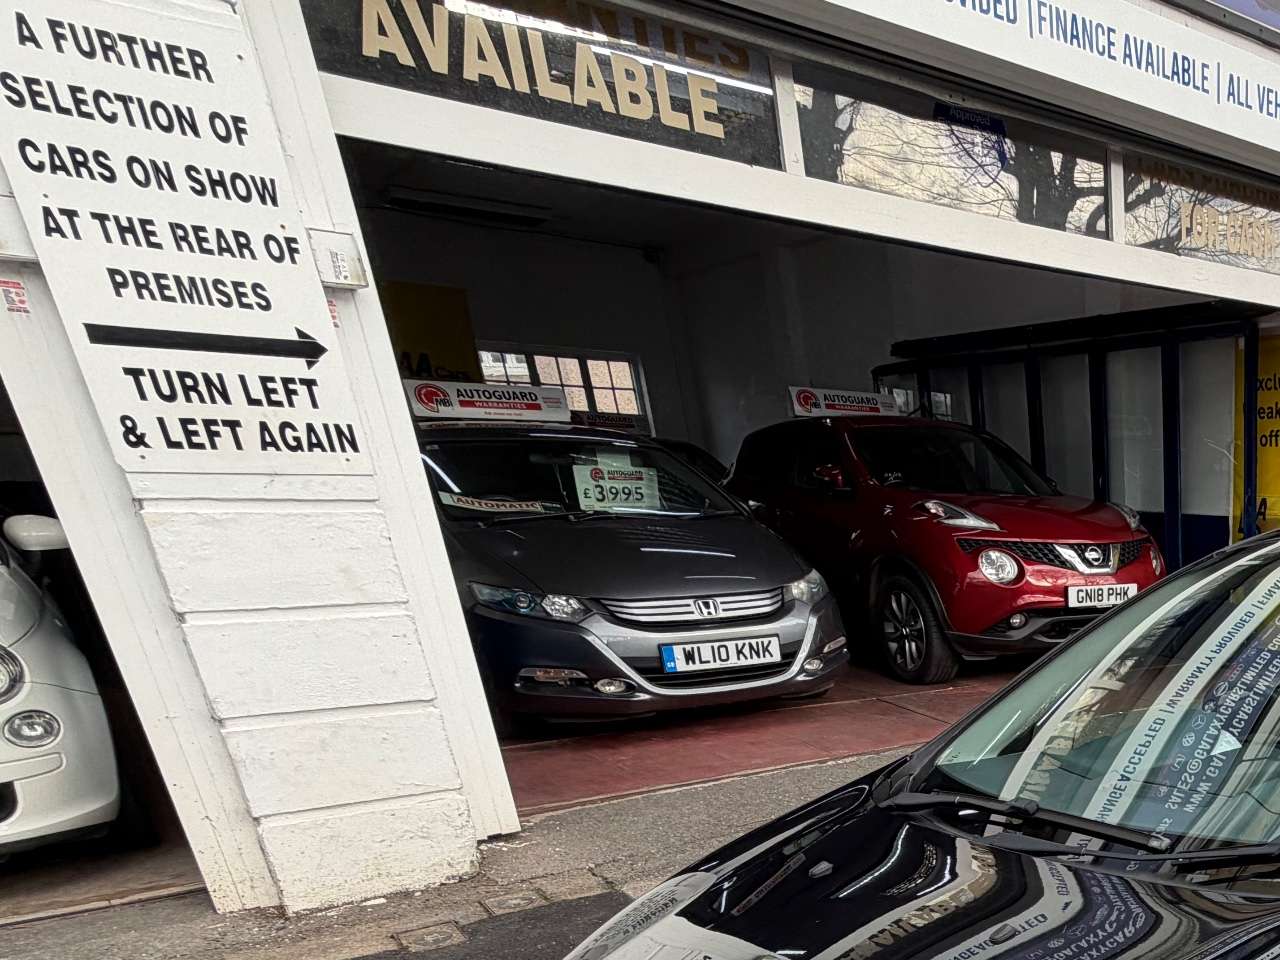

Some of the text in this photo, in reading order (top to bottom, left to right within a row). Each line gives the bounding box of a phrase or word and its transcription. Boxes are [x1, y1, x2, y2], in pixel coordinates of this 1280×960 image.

[15, 12, 215, 83] A FURTHER
[361, 0, 726, 139] AVAILABLE
[1038, 1, 1117, 62] FINANCE
[1123, 35, 1210, 94] AVAILABLE
[1227, 72, 1253, 111] ALL
[0, 72, 249, 146] SELECTION OF
[18, 138, 280, 207] CARS ON SHOW
[42, 206, 82, 240] AT
[89, 212, 164, 250] THE
[169, 222, 257, 261] REAR
[263, 234, 301, 265] OF
[106, 267, 272, 312] PREMISES
[122, 367, 320, 410] TURN LEFT
[456, 388, 539, 402] AUTOGUARD
[824, 394, 878, 406] AUTOGUARD
[122, 414, 361, 453] & LEFT AGAIN
[456, 497, 537, 510] AUTOMATIC
[1077, 587, 1130, 603] GN18 PHK
[683, 640, 774, 666] WL10 KNK
